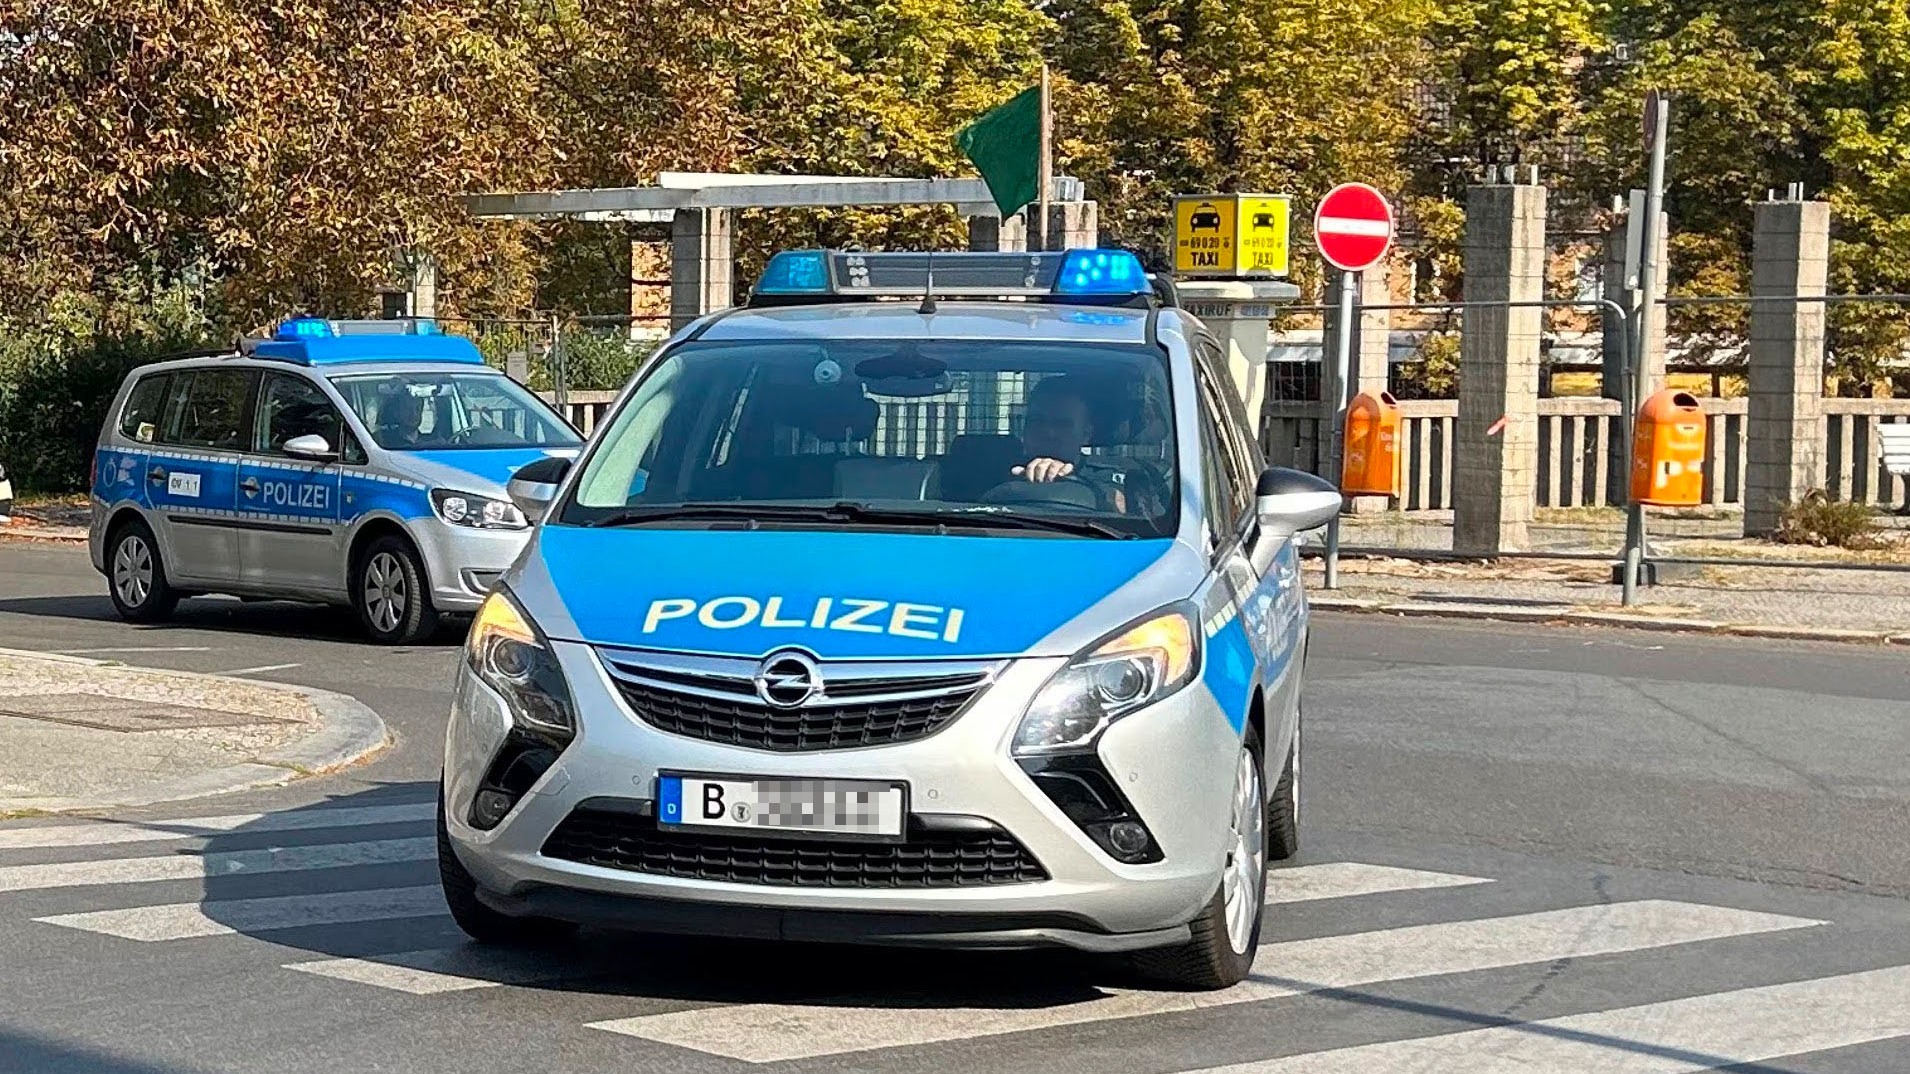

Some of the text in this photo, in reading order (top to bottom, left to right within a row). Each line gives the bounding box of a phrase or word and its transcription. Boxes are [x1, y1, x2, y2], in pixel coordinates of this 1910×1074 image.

[1190, 252, 1219, 266] TAXI
[1252, 251, 1273, 266] TAXI
[263, 482, 330, 509] POLIZEI
[642, 596, 965, 643] POLIZEI
[702, 783, 726, 819] B
